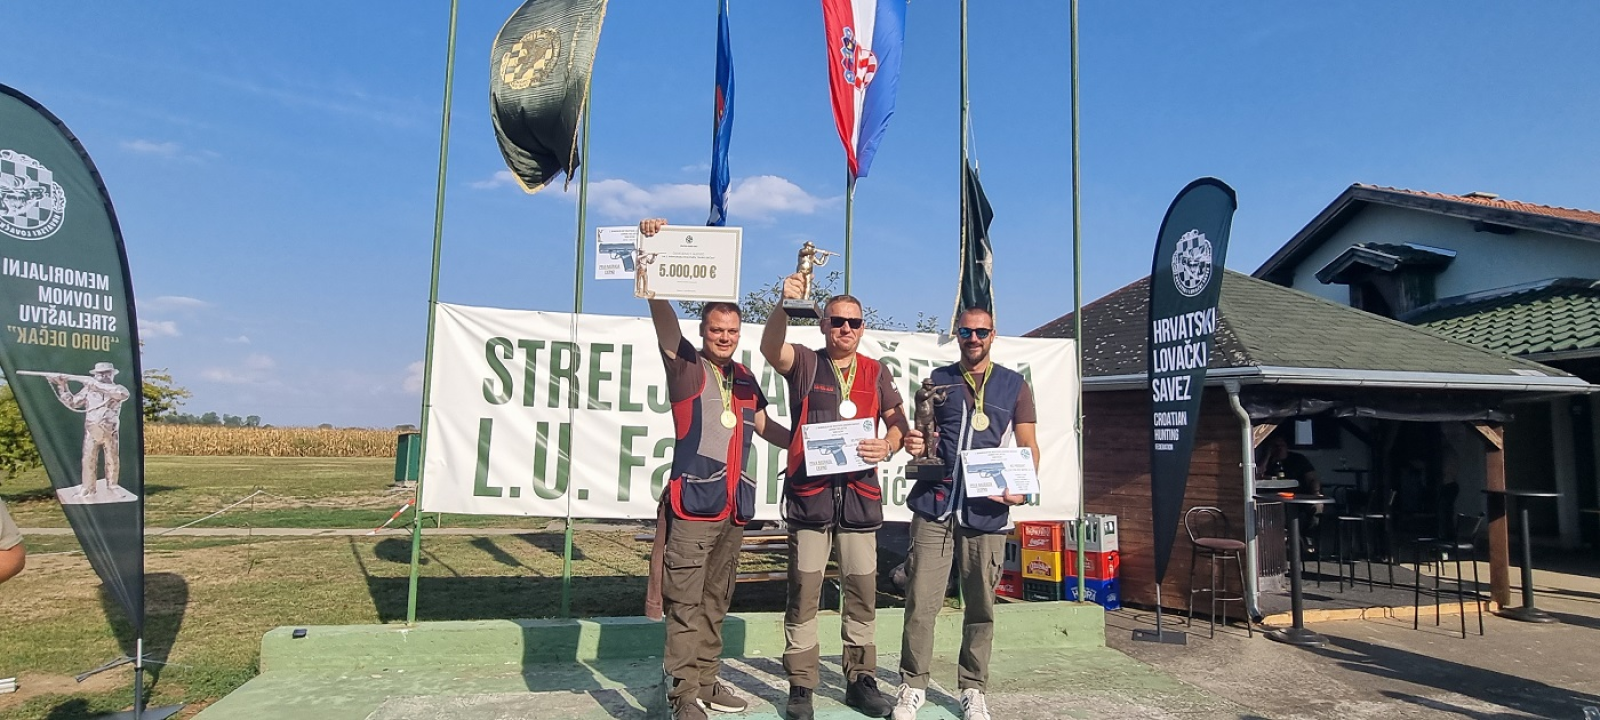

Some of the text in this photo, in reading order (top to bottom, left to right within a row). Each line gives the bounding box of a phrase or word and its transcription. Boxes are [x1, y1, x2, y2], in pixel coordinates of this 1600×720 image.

[659, 263, 717, 280] 5.000,00 €
[1153, 306, 1216, 345] HRVATSKI
[1153, 340, 1207, 373] LOVAČKI
[1152, 375, 1192, 403] SAVEZ
[1153, 411, 1188, 426] CROATIAN
[1154, 428, 1179, 441] HUNTING
[473, 417, 590, 501] L.U.
